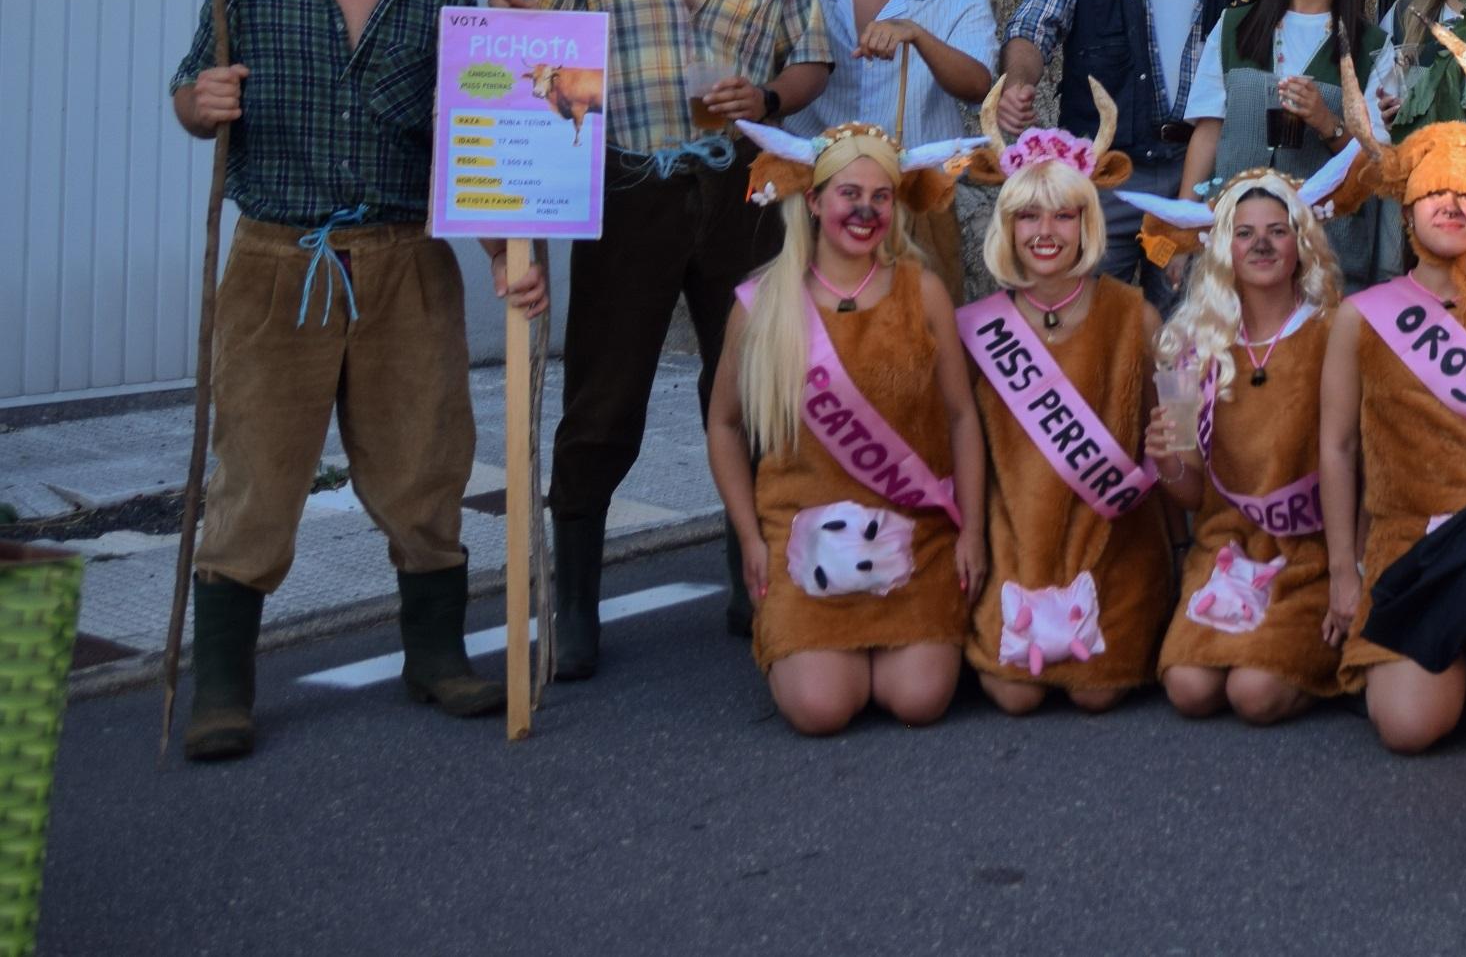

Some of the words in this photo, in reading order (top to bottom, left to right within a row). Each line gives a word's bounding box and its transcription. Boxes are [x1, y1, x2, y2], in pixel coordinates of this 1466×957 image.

[450, 16, 488, 27] VOTA
[469, 35, 578, 60] PICHOTA
[460, 82, 480, 90] MISS
[456, 197, 489, 205] ARTISTA
[491, 197, 530, 205] FAVORITO
[977, 317, 1043, 392] MISS
